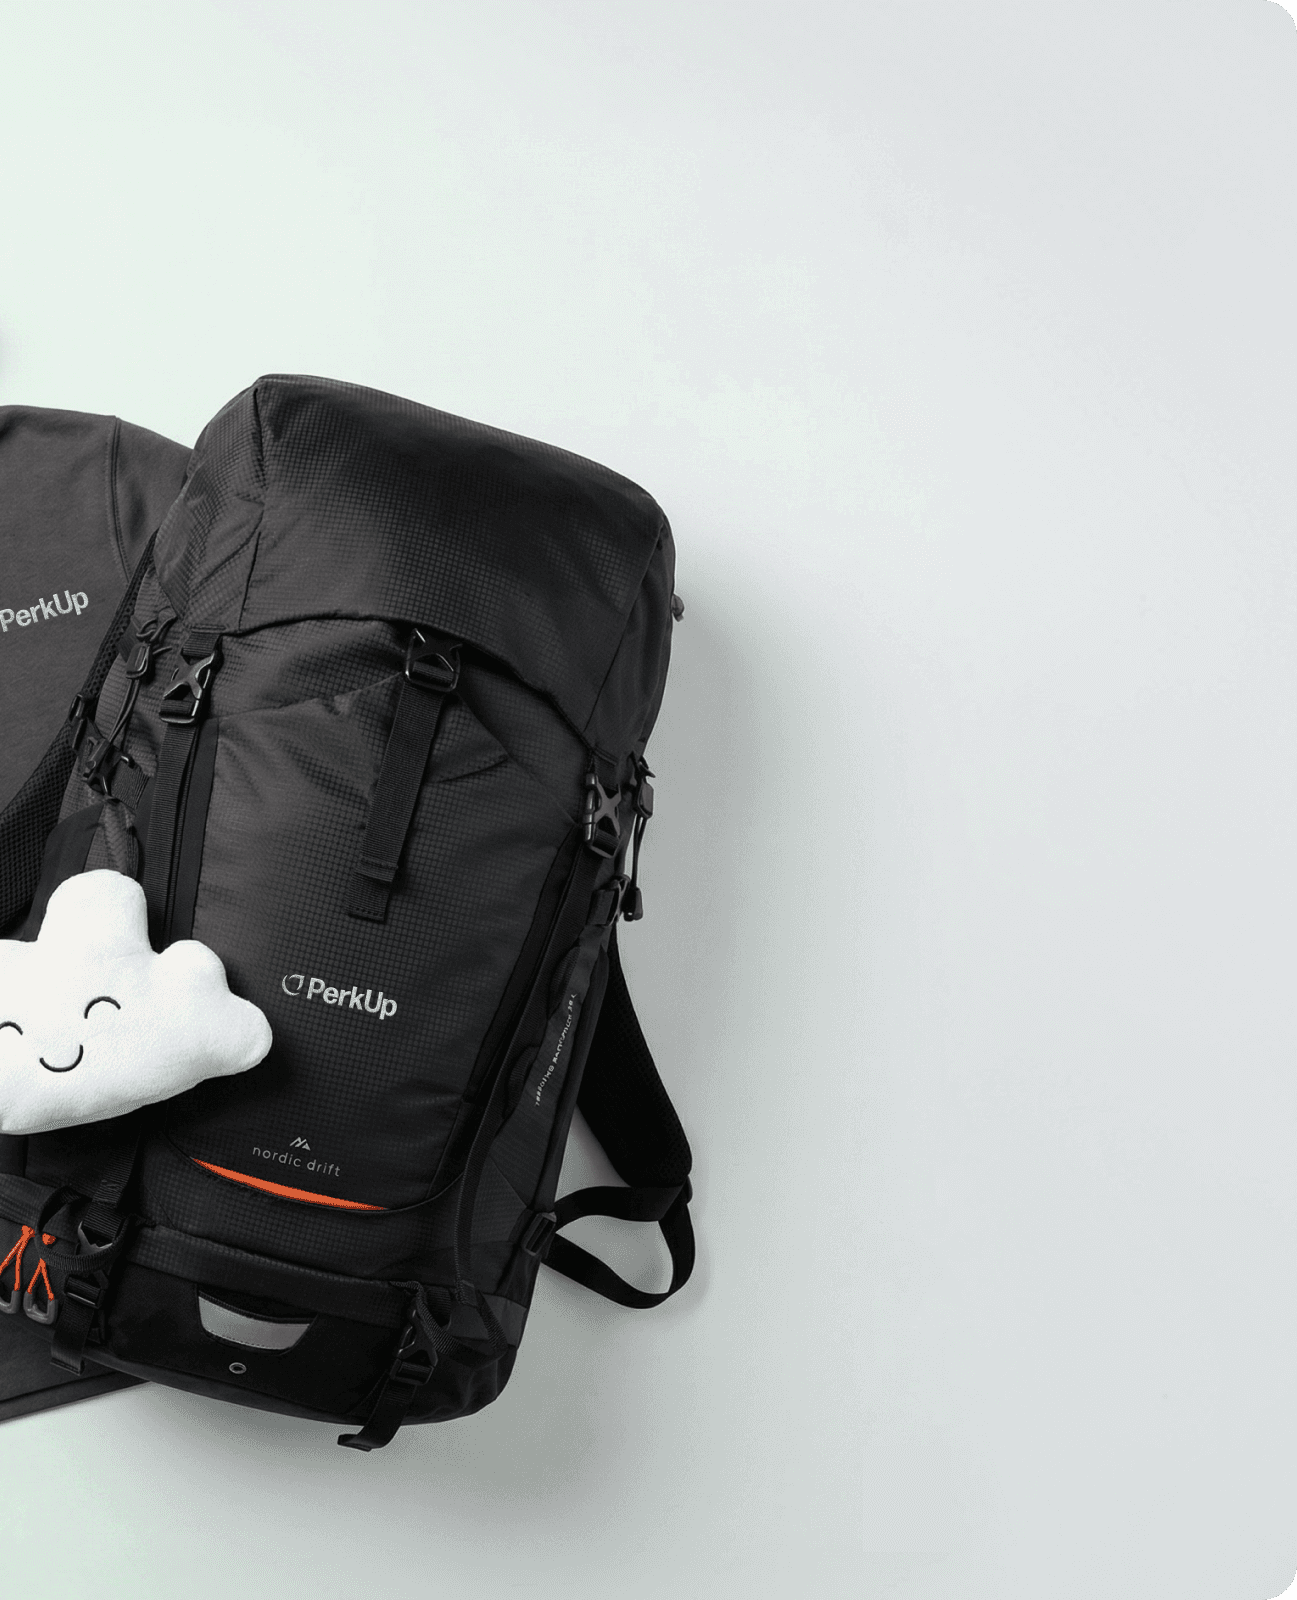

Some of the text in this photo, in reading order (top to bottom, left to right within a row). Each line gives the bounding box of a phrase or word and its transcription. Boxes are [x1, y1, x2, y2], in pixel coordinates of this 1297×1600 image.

[307, 977, 398, 1020] PerkUp
[253, 1146, 341, 1177] nordic drift
